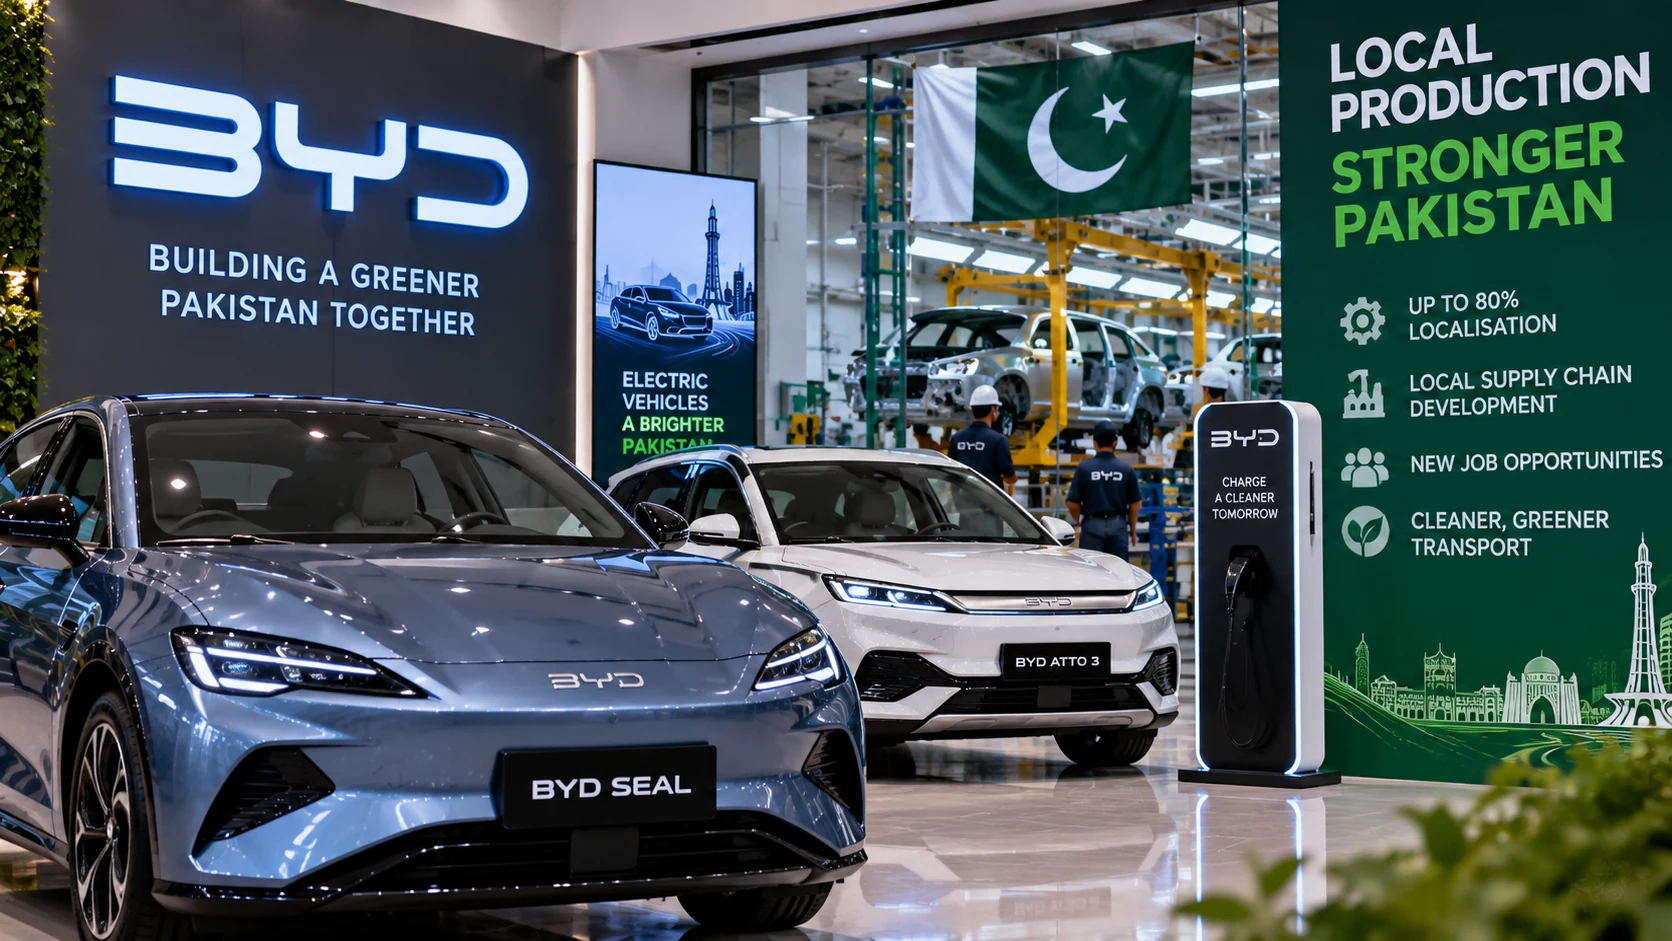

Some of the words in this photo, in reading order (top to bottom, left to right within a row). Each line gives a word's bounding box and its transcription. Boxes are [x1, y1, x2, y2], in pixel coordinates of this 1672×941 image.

[1331, 23, 1493, 83] LOCAL
[1331, 51, 1650, 133] PRODUCTION
[111, 74, 530, 230] BYD
[1331, 120, 1625, 194] STRONGER
[1335, 177, 1613, 248] PAKISTAN
[149, 243, 307, 283] BUILDING
[318, 259, 340, 286] A
[350, 262, 480, 298] GREENER
[161, 288, 318, 326] PAKISTAN
[329, 301, 475, 336] TOGETHER
[1409, 296, 1436, 315] UP
[1440, 293, 1469, 313] TO
[1475, 289, 1519, 310] 80%
[1409, 314, 1557, 341] LOCALISATION
[622, 370, 709, 390] ELECTRIC
[1410, 372, 1475, 392] LOCAL
[1480, 367, 1558, 389] SUPPLY
[1563, 364, 1632, 386] CHAIN
[622, 393, 709, 412] VEHICLES
[1410, 394, 1558, 418] DEVELOPMENT
[621, 415, 635, 432] A
[639, 415, 724, 433] BRIGHTER
[957, 441, 986, 451] BYD
[1210, 428, 1280, 448] BYD
[1411, 454, 1456, 473] NEW
[1460, 453, 1498, 472] JOB
[1503, 449, 1664, 471] OPPORTUNITIES
[1090, 470, 1123, 481] BYD
[1222, 476, 1267, 488] CHARGE
[1214, 492, 1223, 503] A
[1225, 492, 1275, 504] CLEANER
[1212, 508, 1279, 520] TOMORROW
[1411, 511, 1507, 532] CLEANER,
[1512, 510, 1610, 529] GREENER
[1410, 537, 1533, 557] TRANSPORT
[1025, 597, 1072, 607] BYD
[1015, 657, 1047, 668] BYD
[1050, 656, 1087, 667] ATTO
[1091, 656, 1100, 666] 3
[547, 672, 645, 690] BYD
[532, 777, 602, 800] BYD
[611, 775, 692, 797] SEAL
